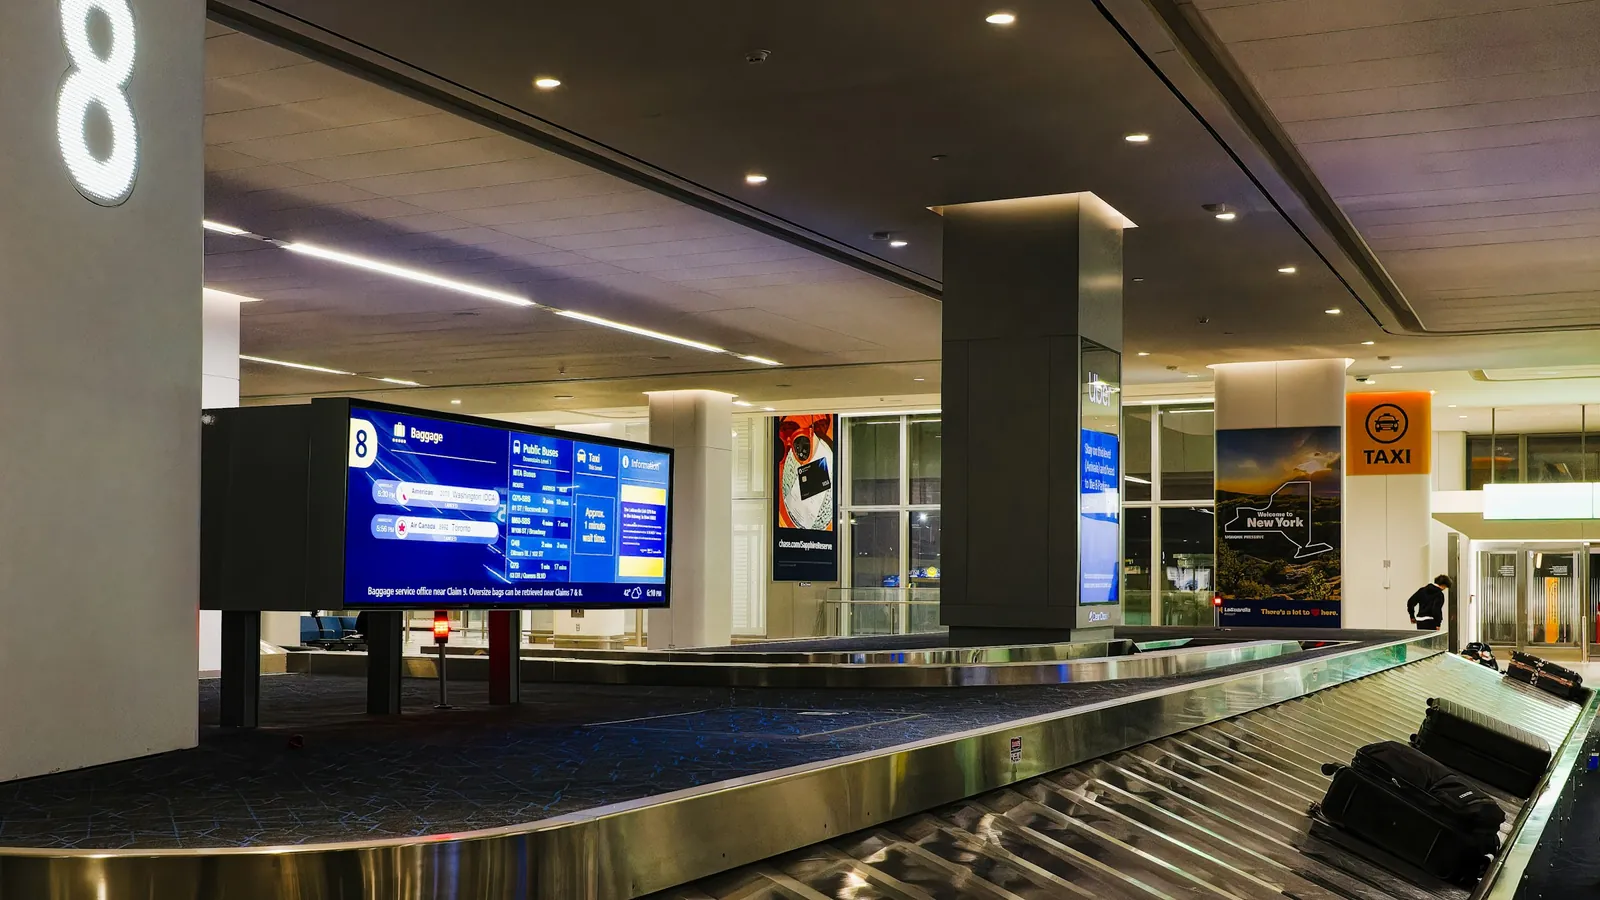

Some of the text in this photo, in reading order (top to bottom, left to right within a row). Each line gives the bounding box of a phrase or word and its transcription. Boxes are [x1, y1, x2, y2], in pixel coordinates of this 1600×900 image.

[57, 0, 137, 200] 8
[1088, 371, 1112, 407] Uber
[410, 427, 444, 444] Baggage
[355, 429, 368, 458] 8
[523, 443, 559, 458] Public Buses
[1364, 449, 1411, 464] TAXI
[588, 453, 600, 463] Taxi
[631, 458, 660, 471] Information
[513, 469, 523, 477] MTA
[411, 488, 434, 496] American
[452, 491, 482, 502] Washington
[585, 507, 605, 519] Approx.
[418, 522, 436, 530] Canada
[452, 523, 471, 532] Toronto
[584, 520, 606, 531] 1 minute
[1247, 517, 1304, 528] New York
[582, 533, 606, 543] wait time.
[367, 587, 394, 597] Baggage
[395, 587, 415, 596] service
[416, 587, 432, 596] office
[433, 588, 446, 596] near
[447, 587, 462, 596] Claim
[469, 587, 491, 596] Oversize
[492, 588, 504, 597] bags
[514, 587, 521, 596] be
[522, 587, 544, 596] retrieved
[555, 588, 570, 596] Claims
[1261, 608, 1286, 616] There's
